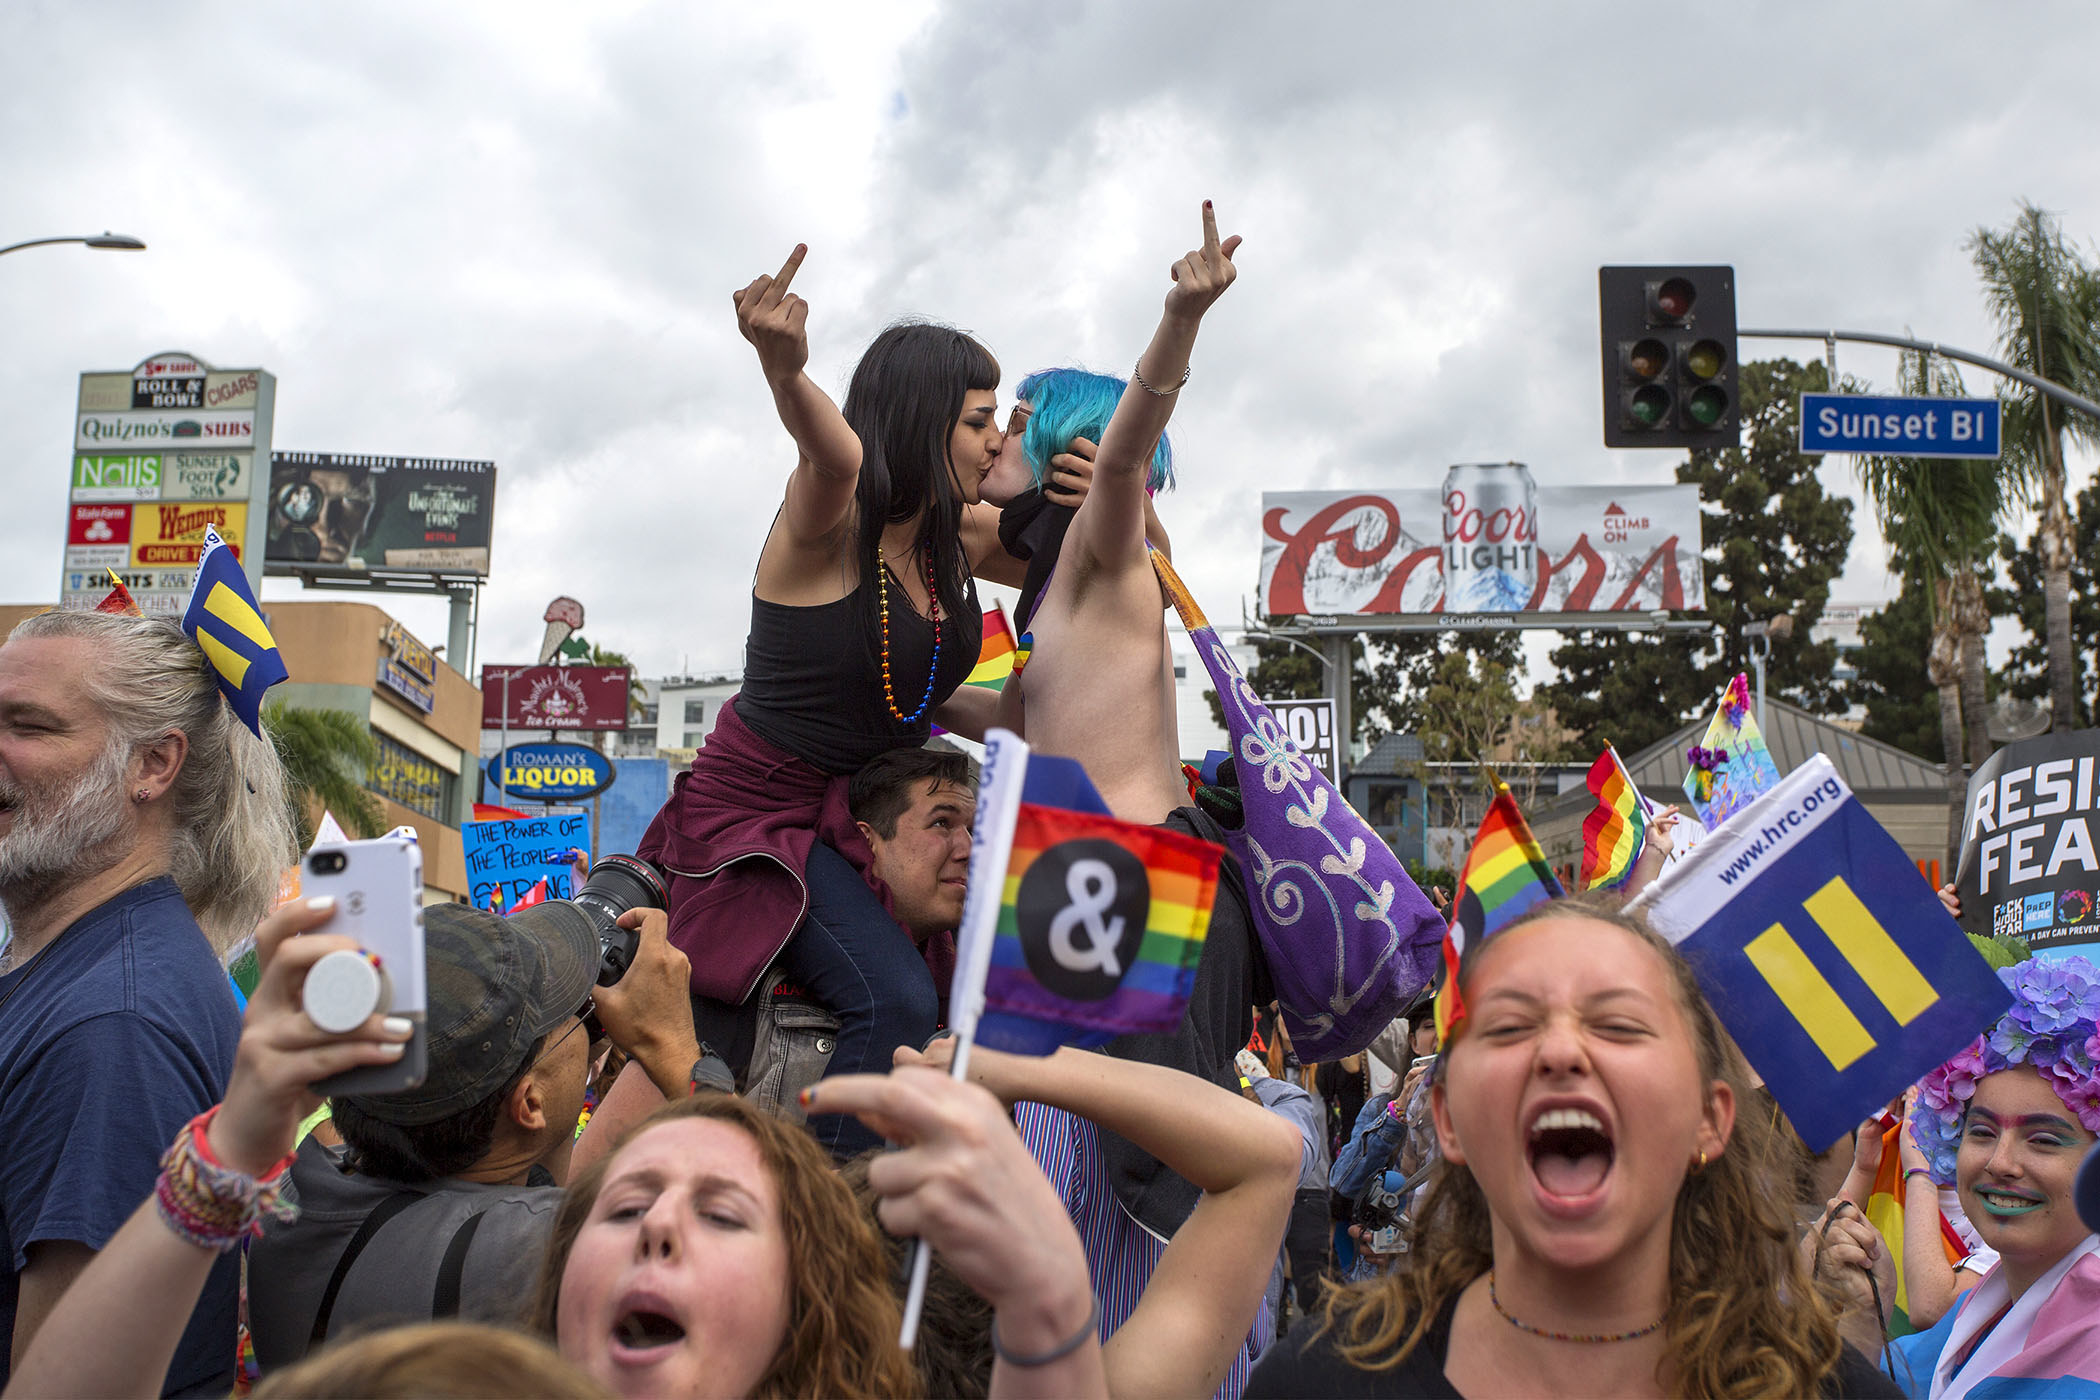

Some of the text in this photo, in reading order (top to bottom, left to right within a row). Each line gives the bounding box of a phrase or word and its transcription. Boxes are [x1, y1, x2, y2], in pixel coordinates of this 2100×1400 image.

[137, 379, 179, 394] ROLL
[206, 372, 258, 407] CIGARS
[152, 392, 200, 408] BOWL
[82, 418, 171, 441] Quizno's
[1817, 407, 1985, 442] Sunset Bl
[176, 454, 226, 468] SUNSET
[178, 470, 214, 483] FOOT
[190, 484, 214, 497] SPA
[1603, 517, 1650, 530] CLIMB
[1603, 531, 1627, 544] ON
[147, 547, 188, 561] DRIVE
[1262, 495, 1700, 612] Cors
[1449, 545, 1531, 571] LIGHT
[87, 574, 152, 588] SHRTS
[513, 751, 587, 766] ROMAN'S
[504, 767, 597, 789] LIQUOR
[1970, 757, 2100, 841] RESI
[468, 816, 584, 844] THE POWER OF
[1718, 778, 1841, 885] www.hrc.org
[466, 846, 497, 875] THE
[495, 843, 556, 870] PEOPLE
[473, 875, 570, 912] STRNG
[1049, 859, 1126, 976] &
[2025, 909, 2051, 923] HERE
[1994, 920, 2023, 936] FEAR
[2031, 932, 2037, 942] A
[2037, 929, 2051, 940] DAY
[2052, 927, 2068, 938] CAN
